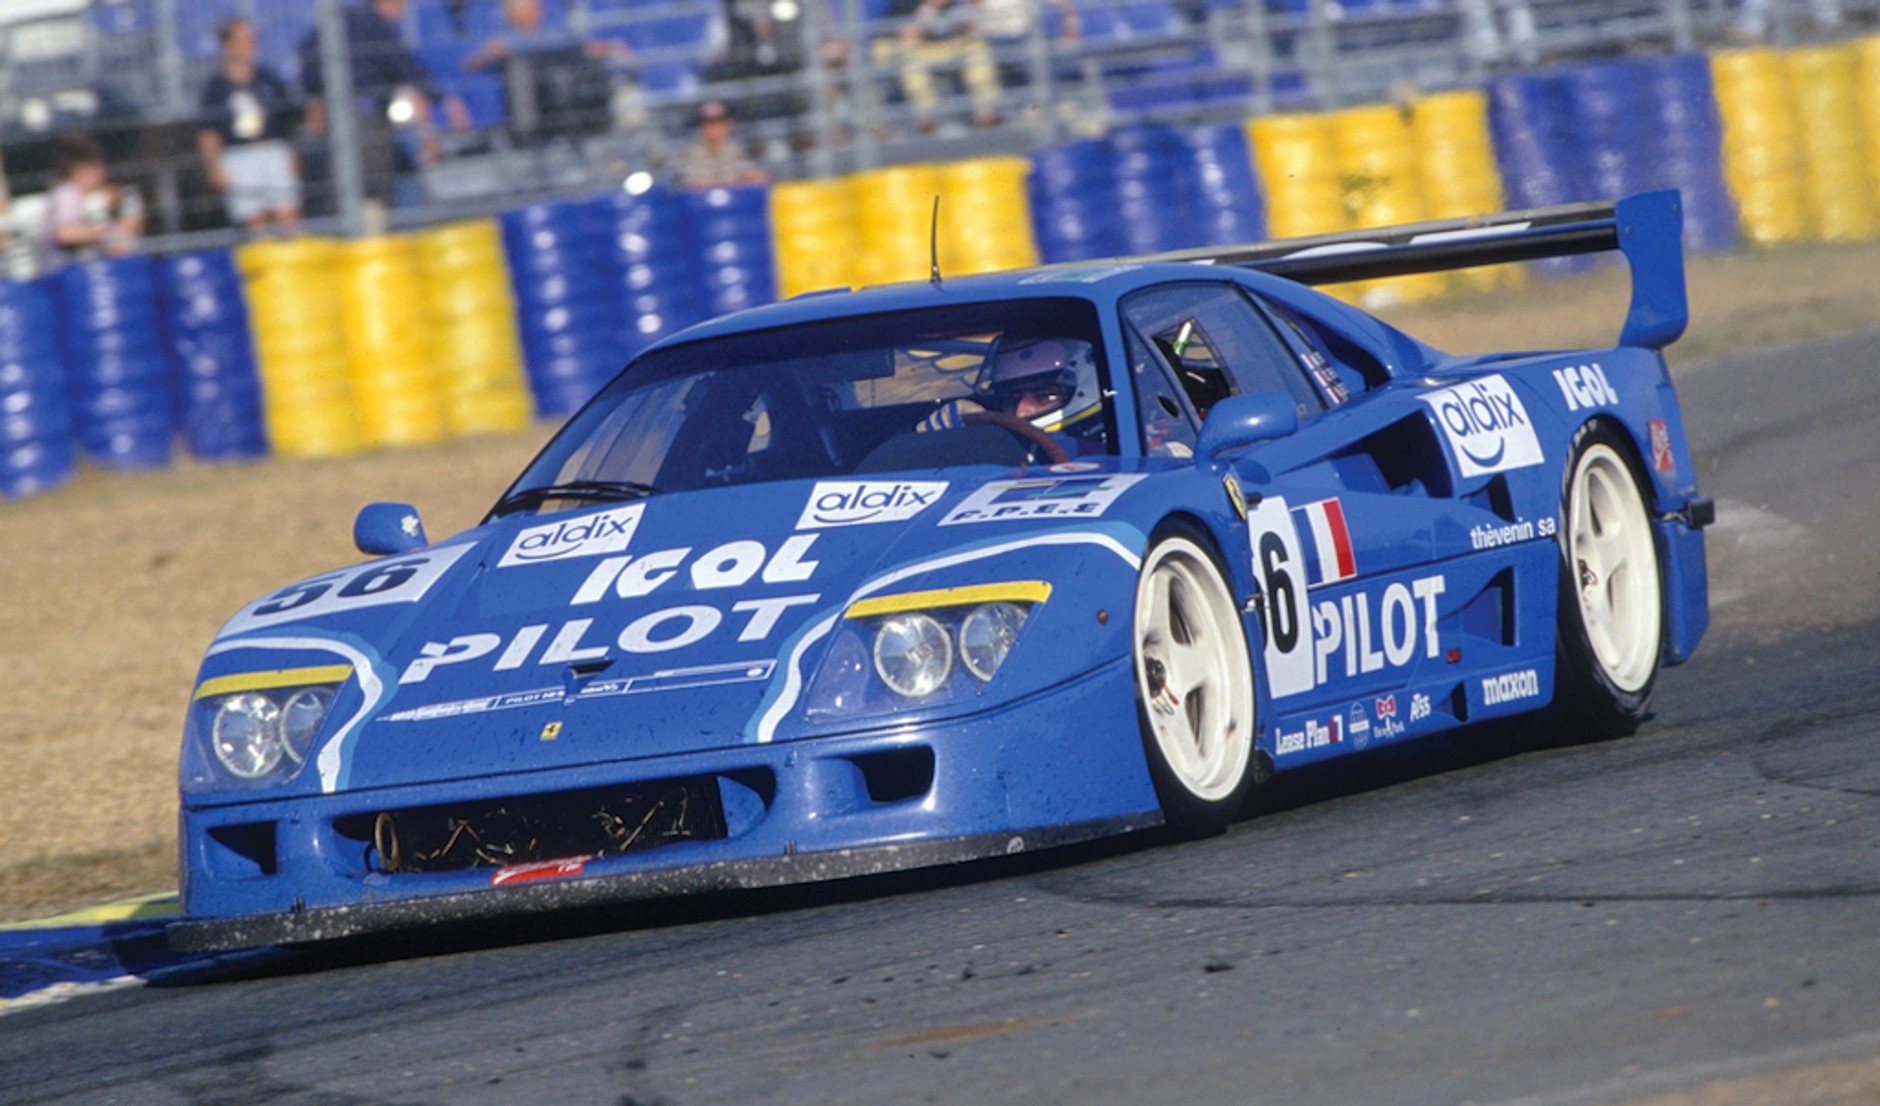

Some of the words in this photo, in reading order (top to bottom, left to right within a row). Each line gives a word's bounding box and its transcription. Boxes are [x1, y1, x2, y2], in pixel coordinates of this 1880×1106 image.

[1442, 382, 1525, 437] aldix
[1552, 363, 1619, 412] IGOL
[816, 484, 936, 512] aldix
[517, 512, 632, 551] aldix
[1538, 517, 1556, 536] sa
[251, 557, 432, 616] 56
[569, 532, 821, 606] IGOL
[1253, 530, 1299, 654] 6
[398, 593, 822, 684] PILOT
[1311, 574, 1447, 686] PILOT
[1482, 669, 1539, 706] maxon
